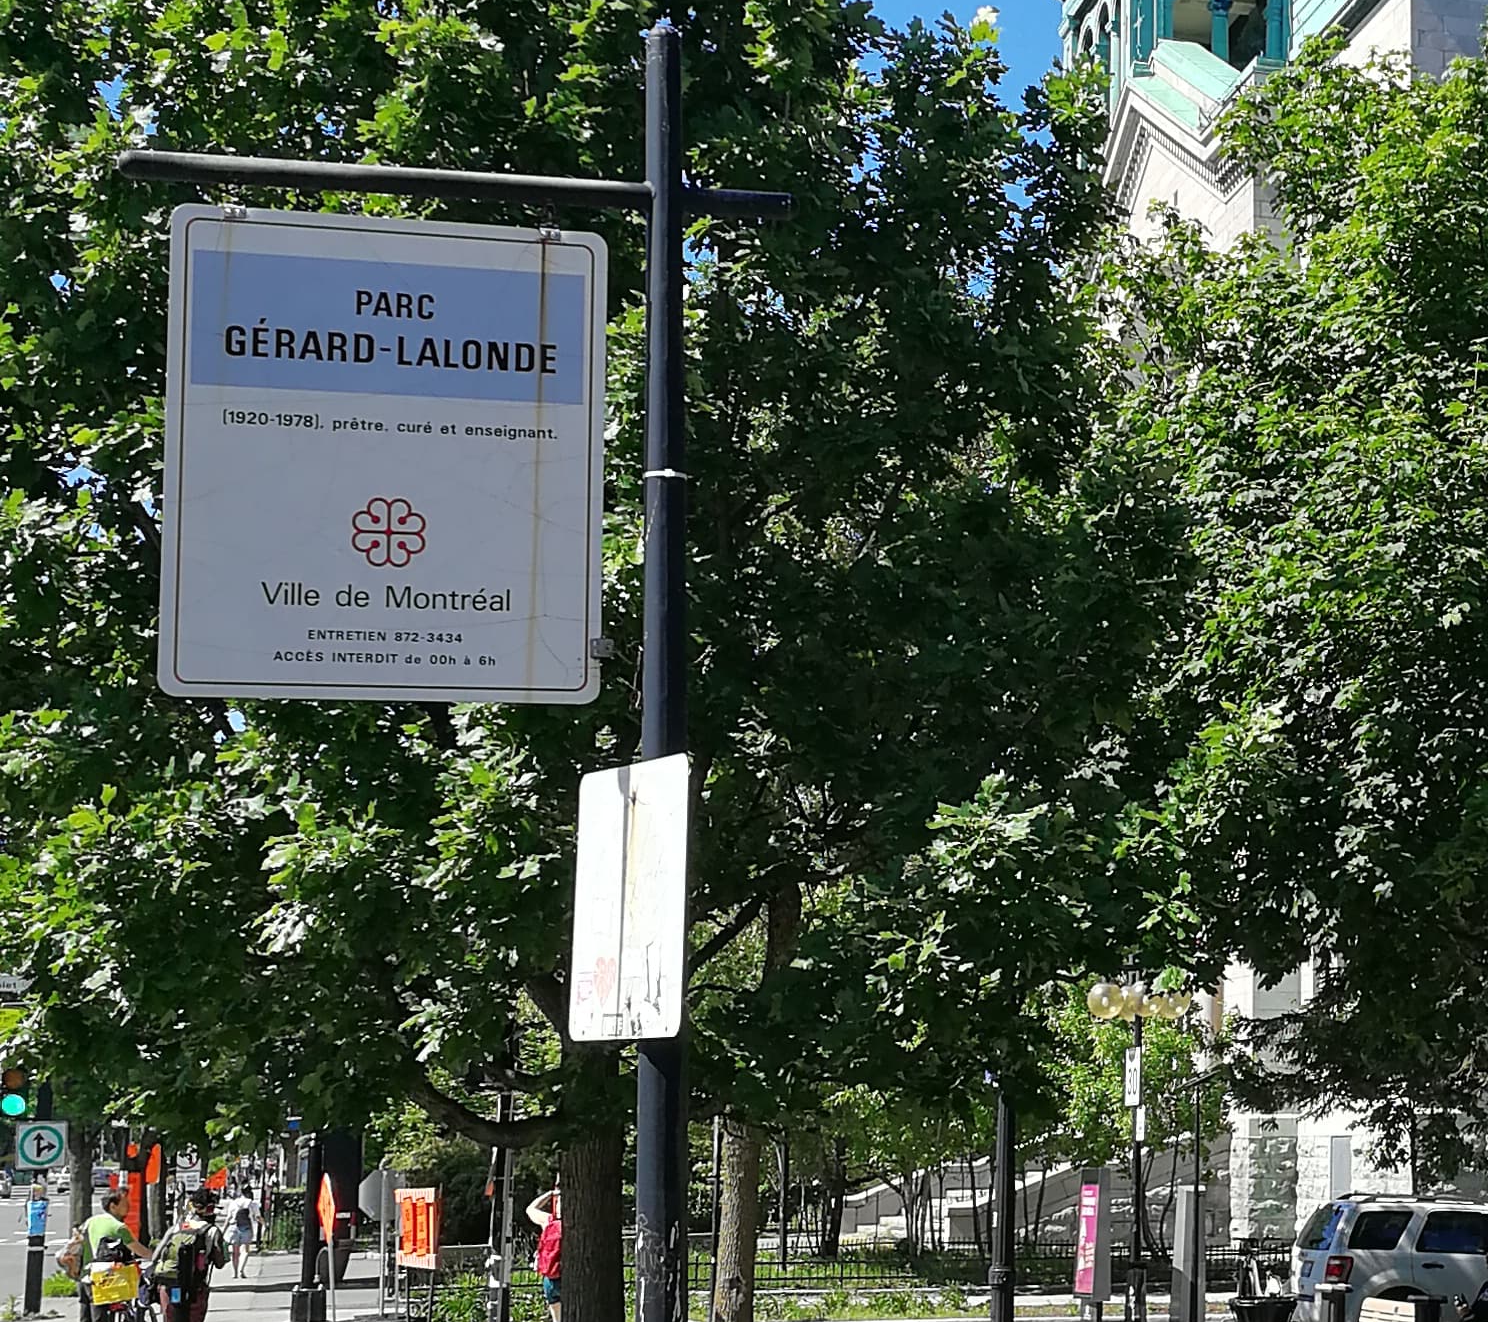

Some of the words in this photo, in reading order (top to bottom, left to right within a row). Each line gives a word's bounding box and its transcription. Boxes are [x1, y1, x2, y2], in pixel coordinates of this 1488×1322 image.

[355, 289, 435, 320] PARC
[224, 317, 557, 374] GÉRARD-LALONDE
[396, 421, 433, 435] curé
[439, 424, 457, 435] et
[464, 425, 558, 441] enseignant.
[261, 581, 321, 607] Ville
[335, 584, 370, 608] de
[385, 585, 512, 612] Montréal
[307, 629, 387, 642] ENTRETIEN
[394, 632, 463, 644] 872-3434
[273, 648, 324, 662] ACCÈS
[331, 652, 398, 665] INTERDIT
[404, 654, 422, 665] de
[429, 654, 456, 665] 00h
[463, 654, 471, 666] à
[478, 655, 497, 666] 6h
[1127, 1068, 1138, 1095] 30
